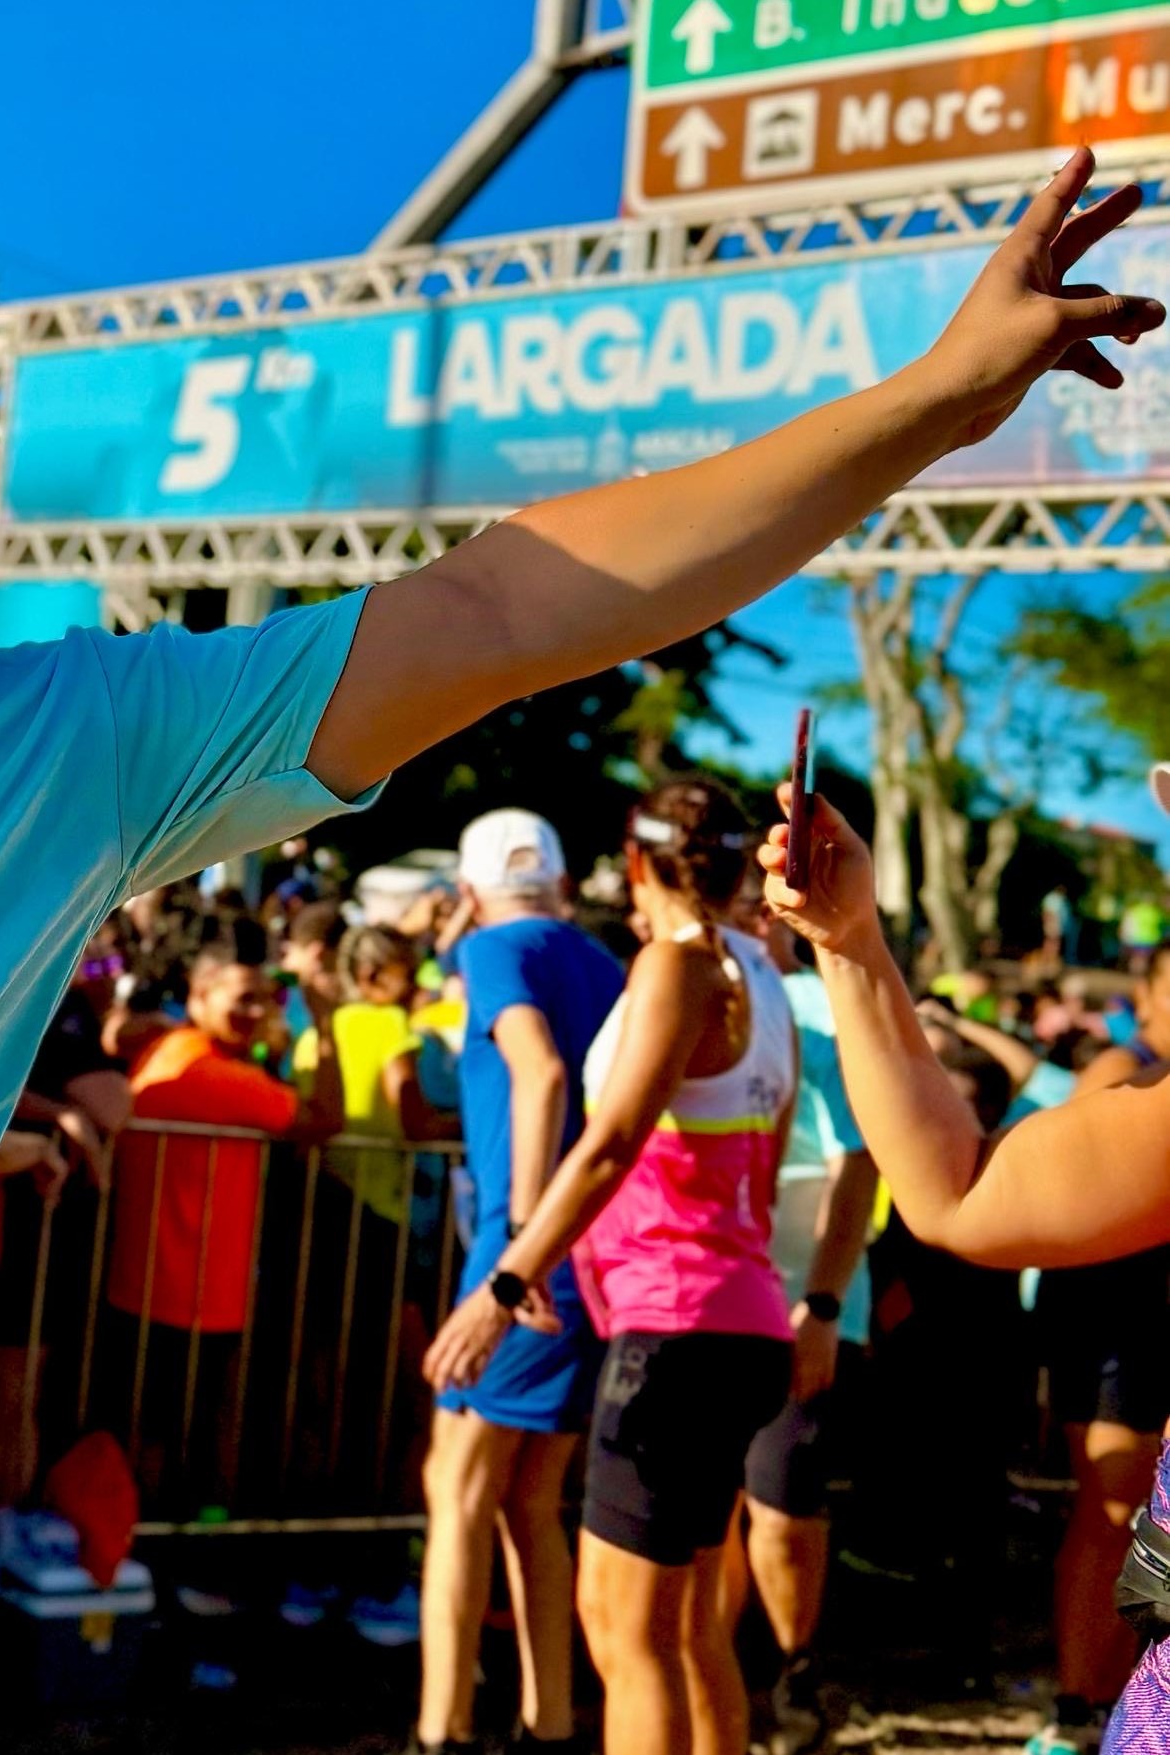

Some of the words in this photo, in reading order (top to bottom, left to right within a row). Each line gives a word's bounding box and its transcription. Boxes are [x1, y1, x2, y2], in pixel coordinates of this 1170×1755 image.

[837, 84, 1027, 153] Merc.
[157, 353, 253, 496] 5
[386, 281, 880, 426] LARGADA
